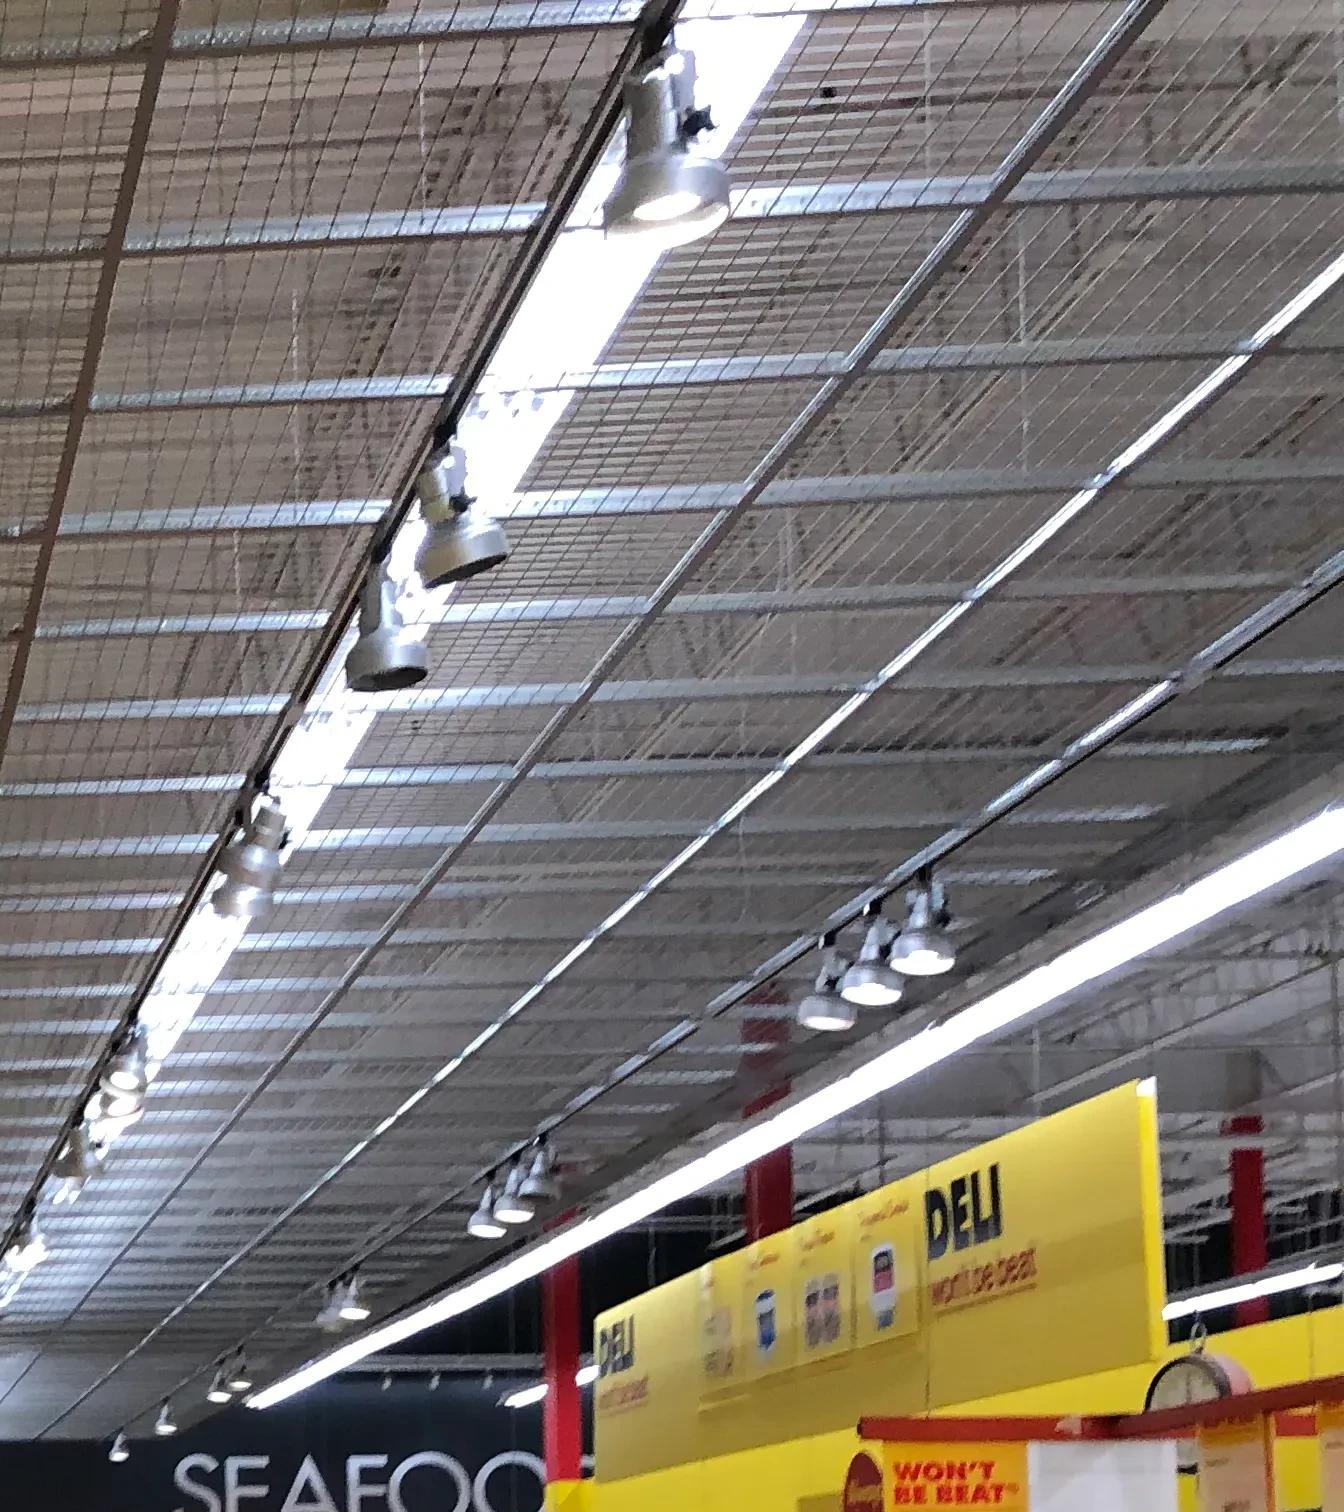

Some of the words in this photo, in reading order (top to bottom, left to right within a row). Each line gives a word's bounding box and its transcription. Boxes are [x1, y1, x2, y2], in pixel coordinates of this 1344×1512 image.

[925, 1161, 1002, 1262] DELI
[894, 1460, 996, 1481] WON'T
[894, 1484, 928, 1504] BE
